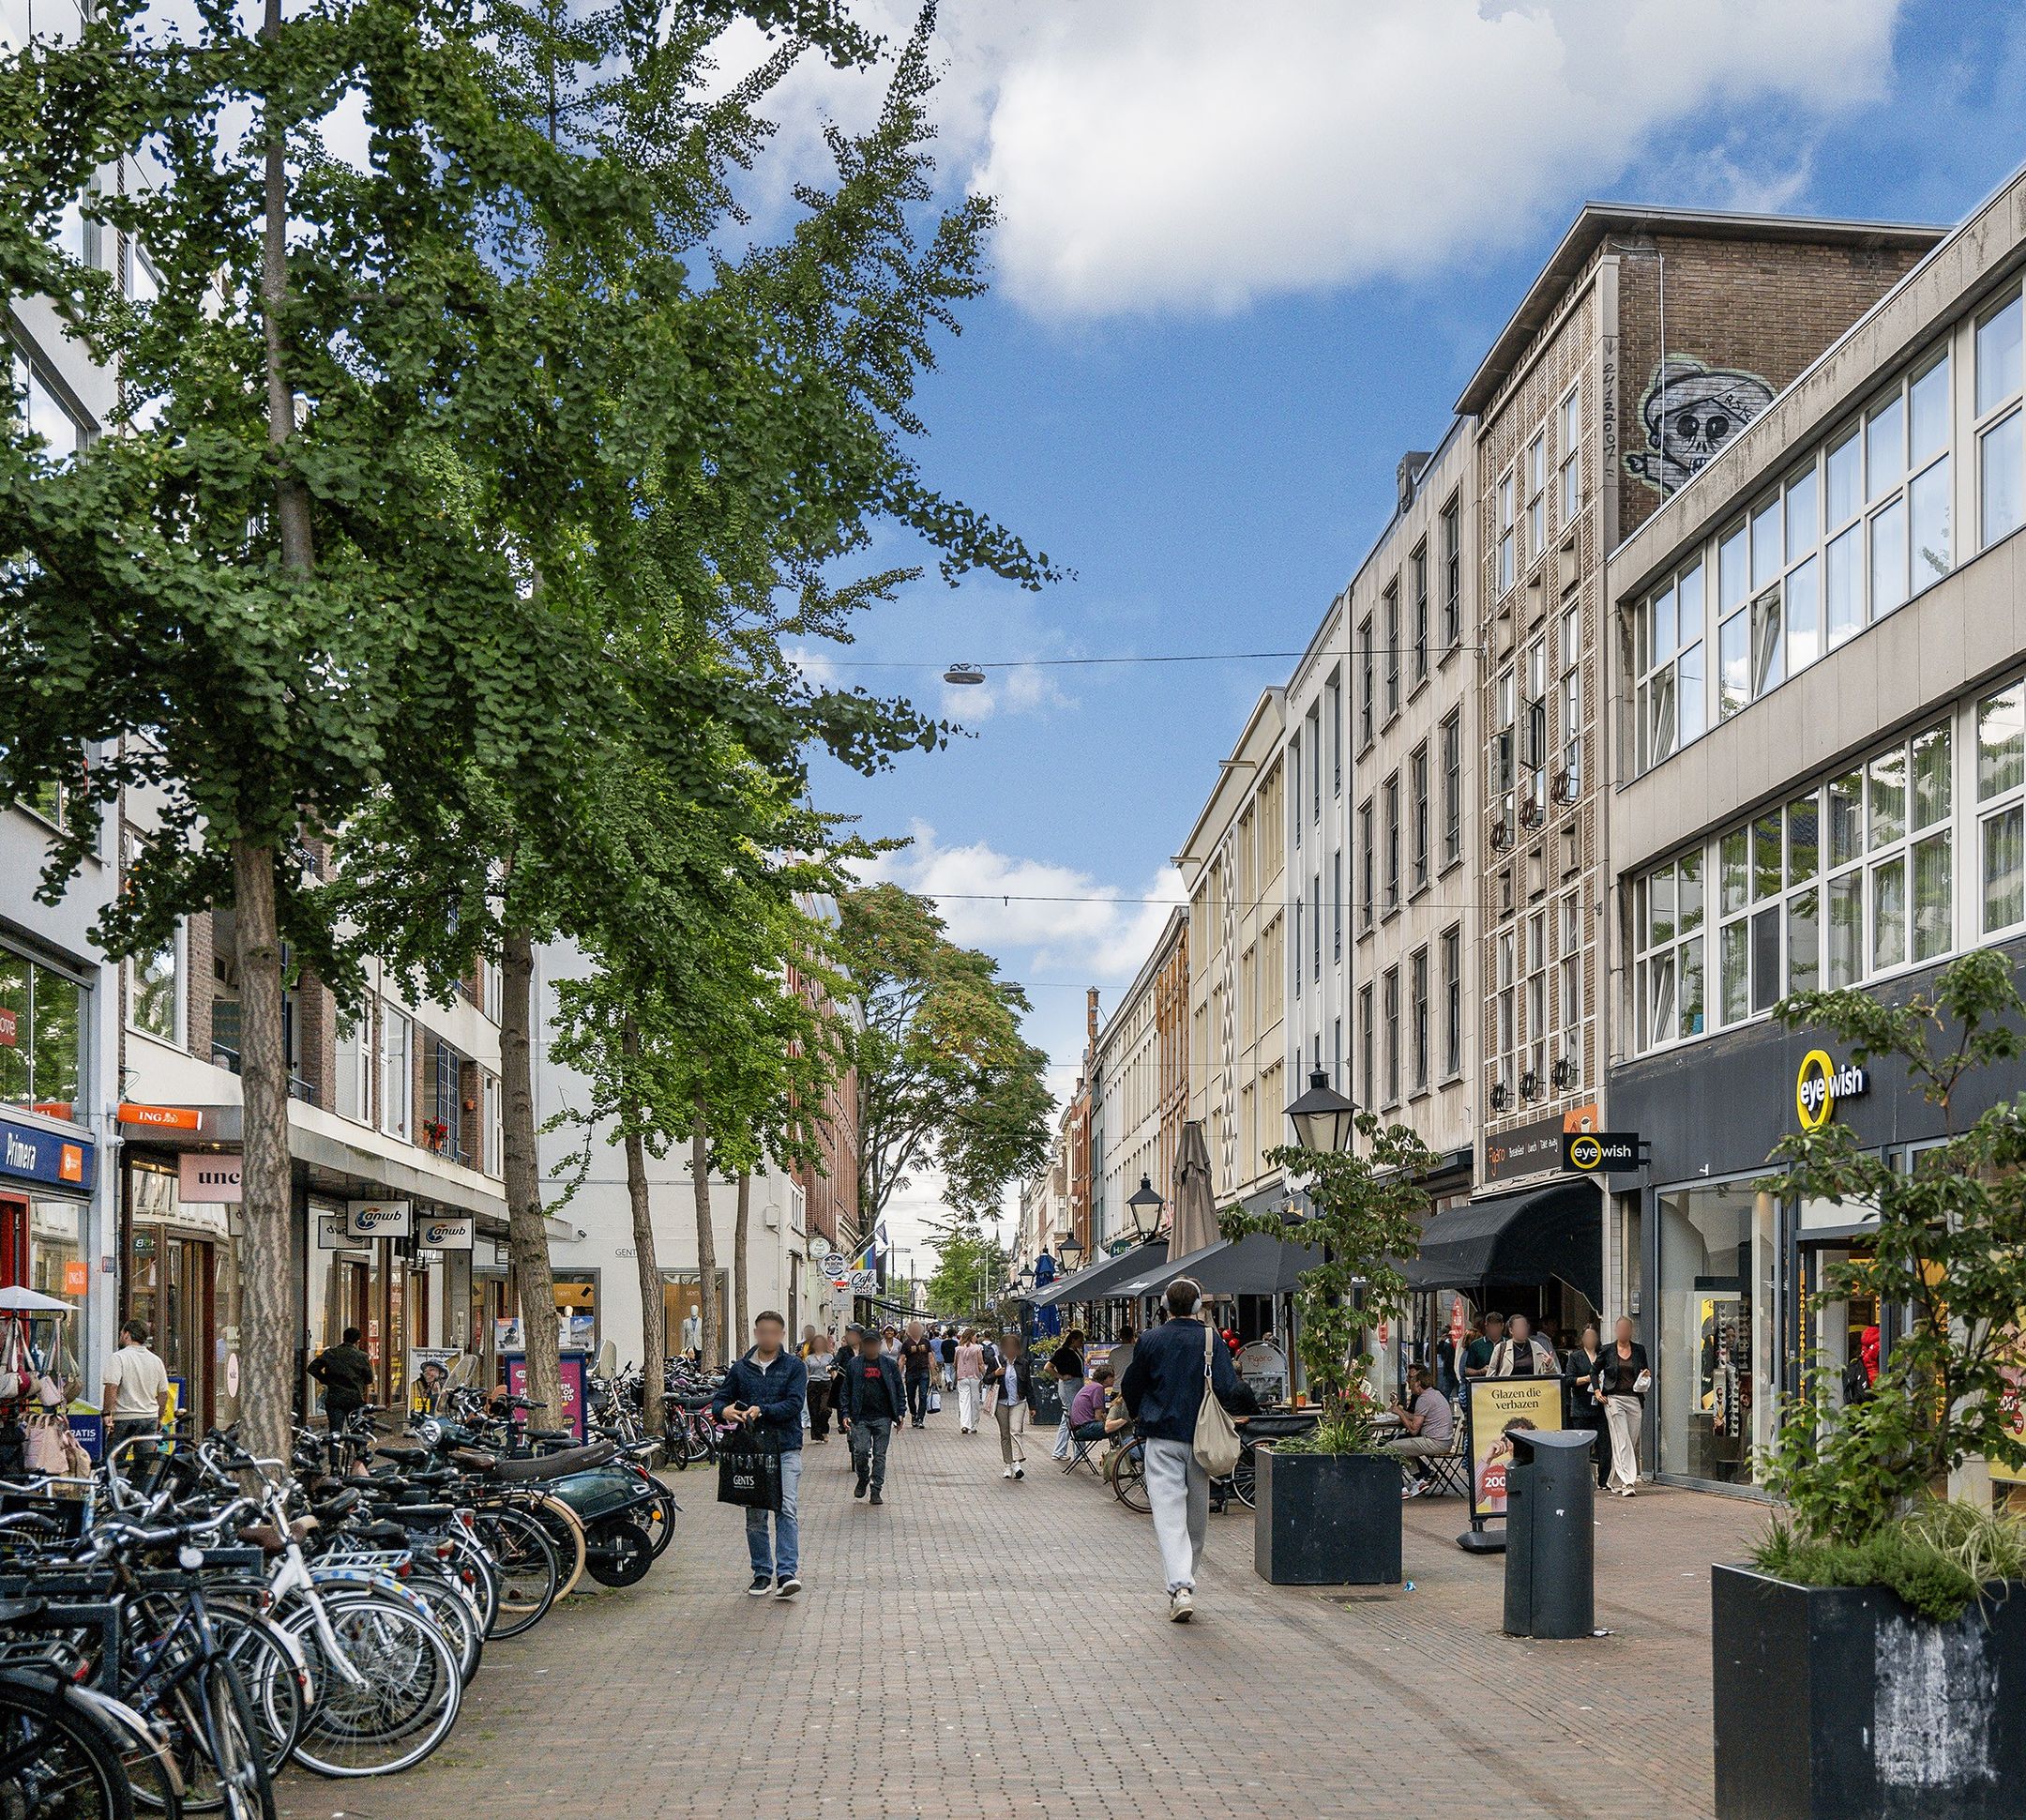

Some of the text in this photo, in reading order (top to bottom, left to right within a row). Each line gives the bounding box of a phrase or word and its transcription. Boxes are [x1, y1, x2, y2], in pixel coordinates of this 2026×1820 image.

[139, 1112, 161, 1121] ING
[7, 1132, 36, 1170] Primera
[1488, 1146, 1505, 1176] Figaro
[365, 1210, 401, 1221] anwb
[434, 1226, 465, 1236] anwb
[1247, 1356, 1273, 1367] Figaro
[1491, 1388, 1541, 1400] Glazen die
[1496, 1400, 1539, 1410] verbazen
[70, 1429, 96, 1437] RATIS
[733, 1474, 755, 1486] GENTS
